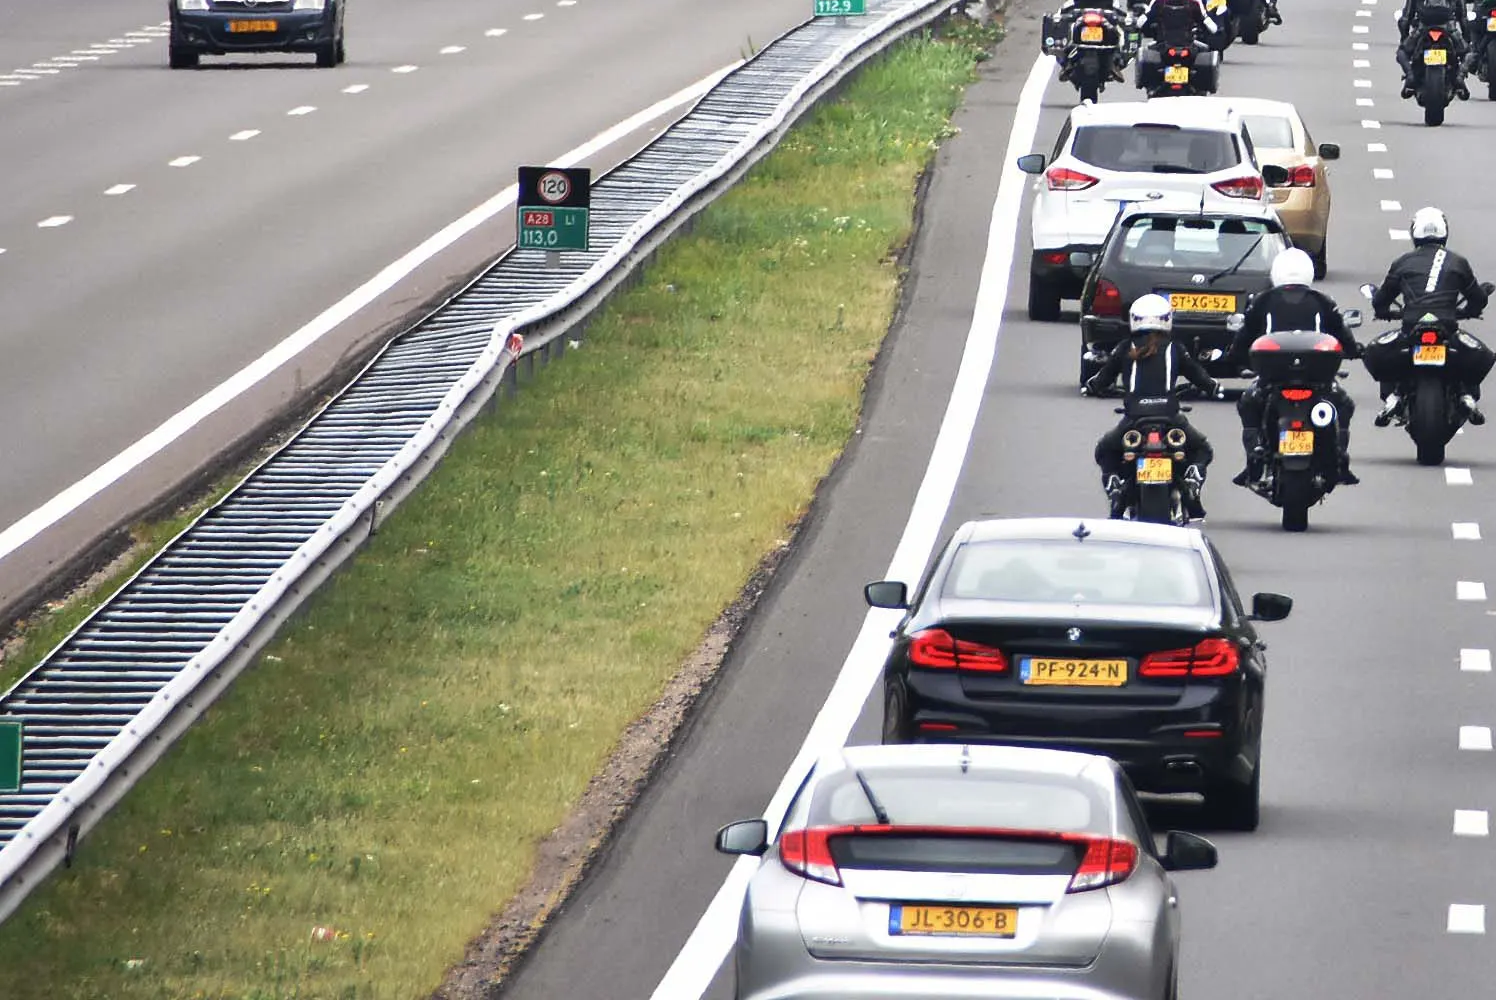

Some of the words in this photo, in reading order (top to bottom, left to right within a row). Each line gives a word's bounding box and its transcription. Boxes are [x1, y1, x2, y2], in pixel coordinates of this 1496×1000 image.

[543, 180, 567, 194] 120
[526, 214, 549, 225] A28
[1171, 295, 1229, 309] ST-XG-52
[1037, 661, 1119, 678] PF-924-N
[911, 908, 1008, 930] JL-306-B
